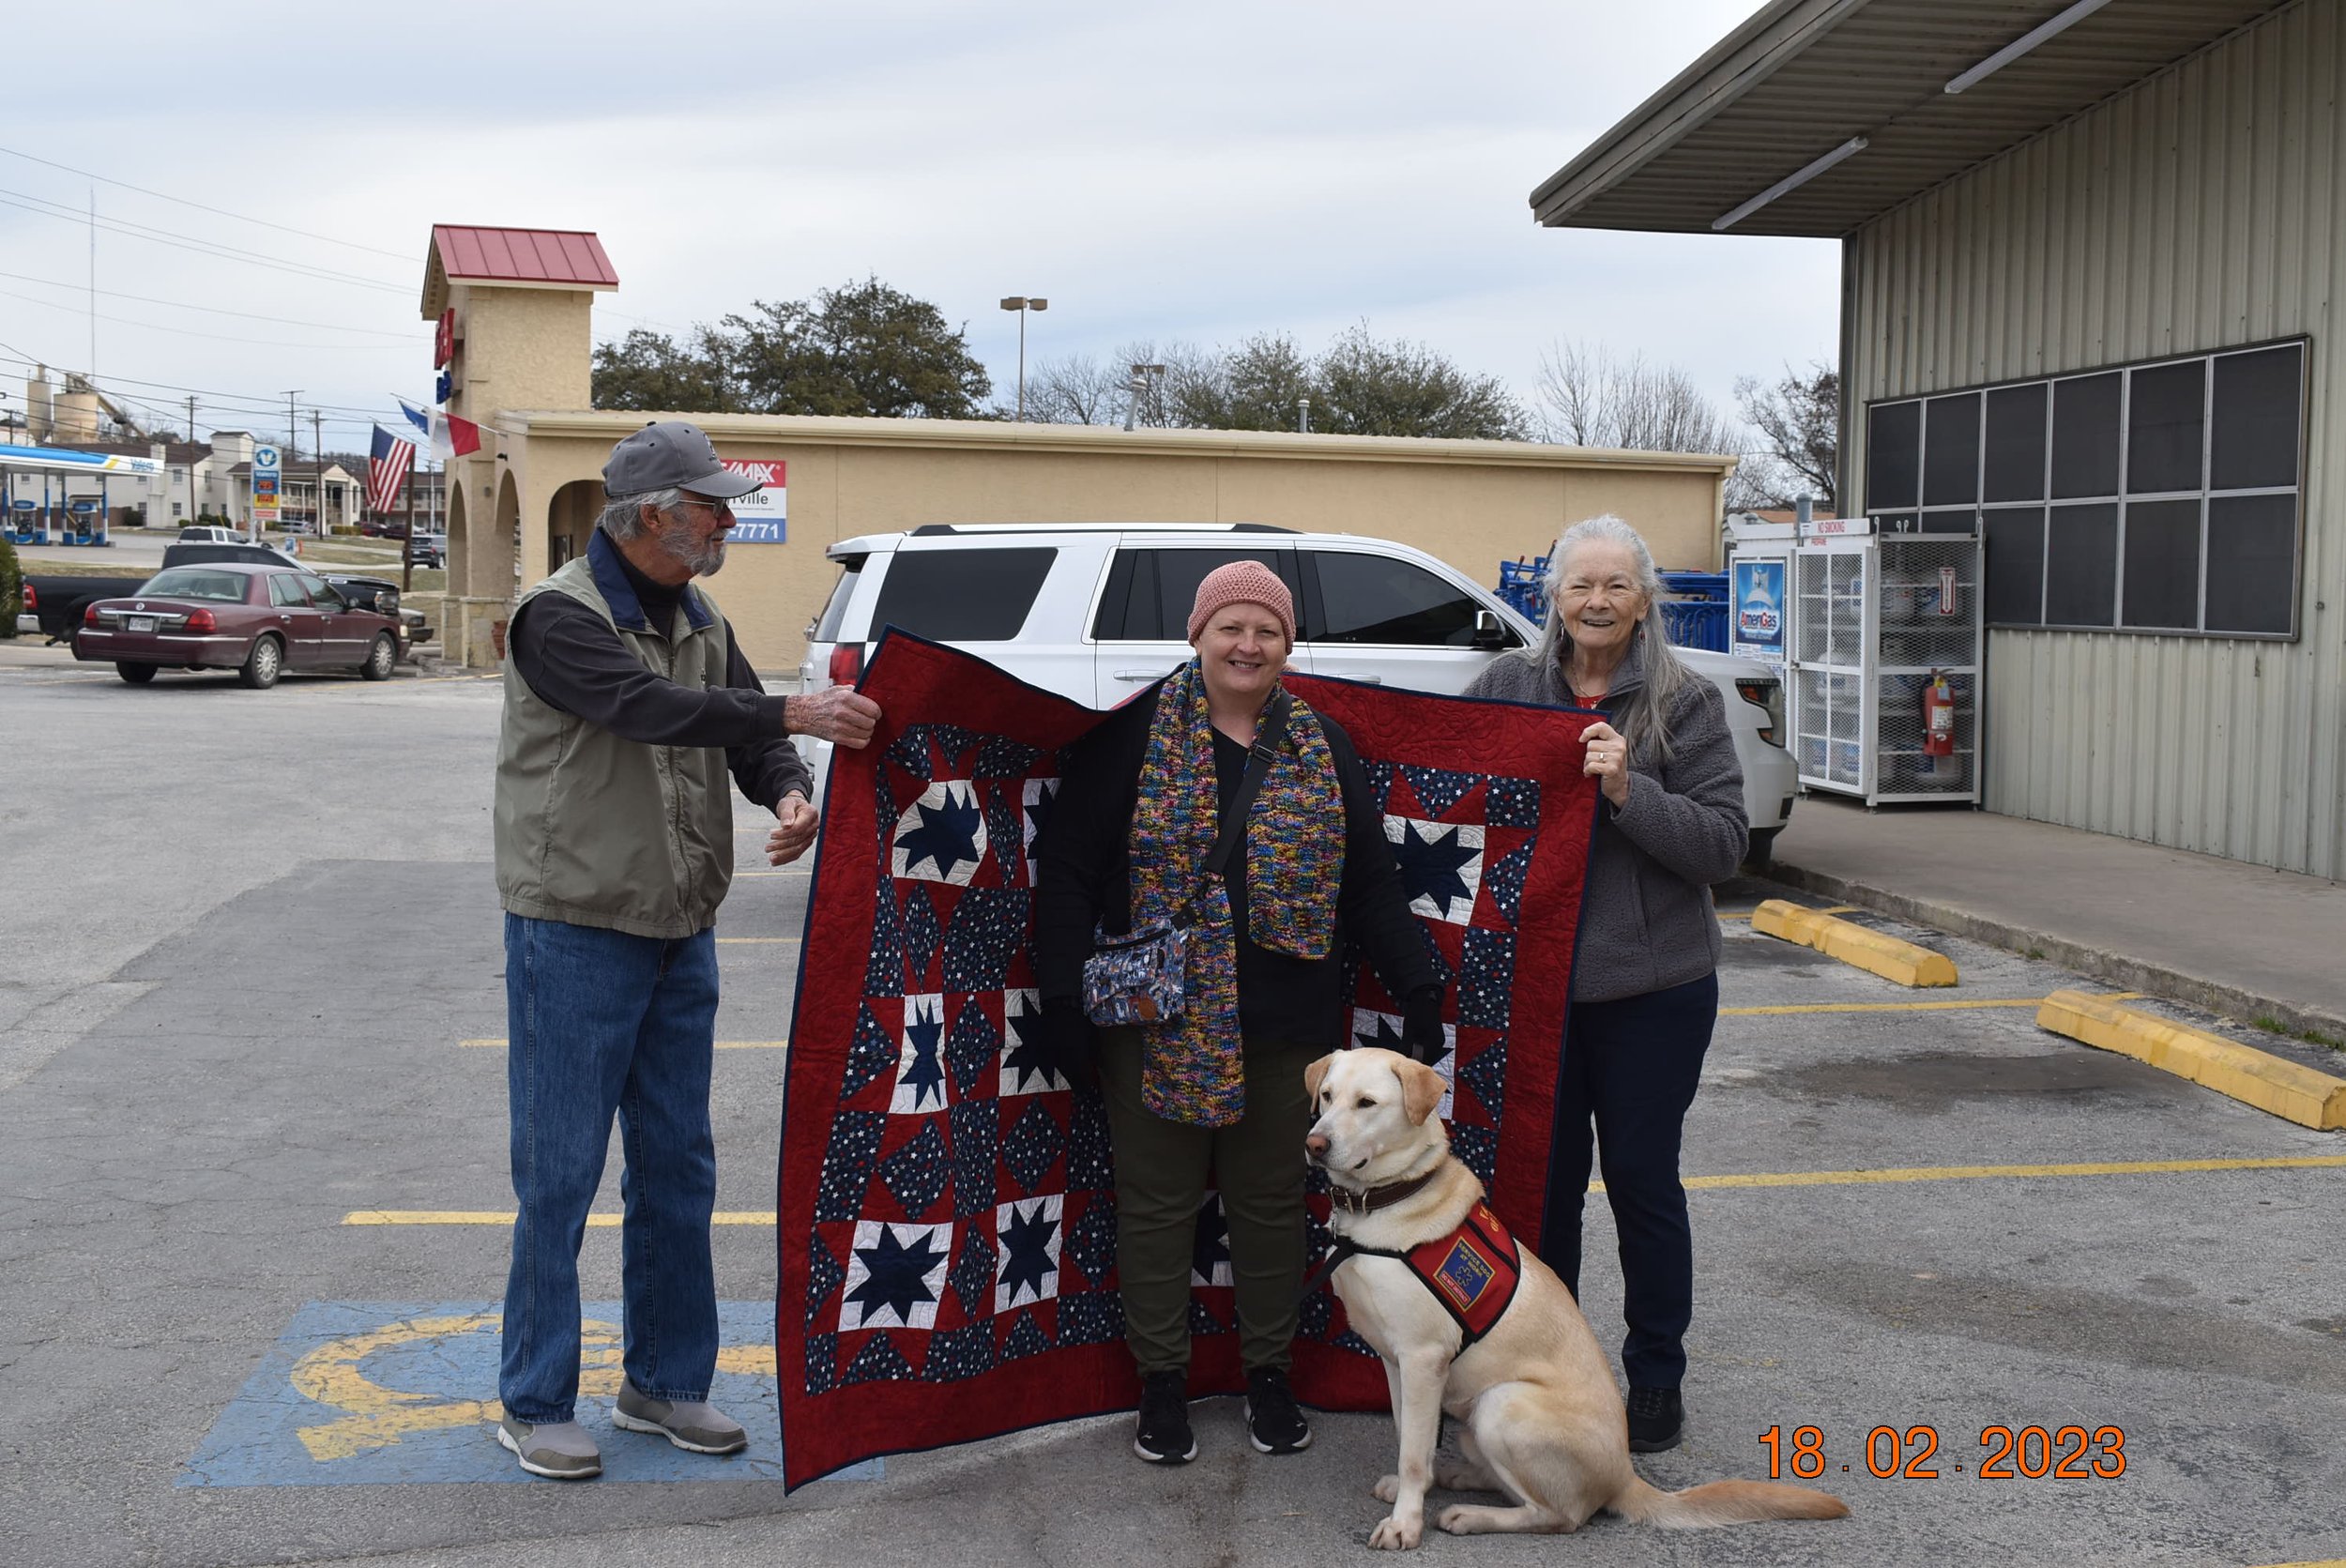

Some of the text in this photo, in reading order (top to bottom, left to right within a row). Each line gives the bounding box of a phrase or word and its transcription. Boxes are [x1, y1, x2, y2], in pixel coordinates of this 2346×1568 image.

[730, 524, 779, 540] -7771
[1818, 523, 1824, 533] NO
[1741, 611, 1777, 628] AmeriGas
[1458, 1242, 1491, 1278] SERVICE DOG
[1468, 1261, 1483, 1277] WORK
